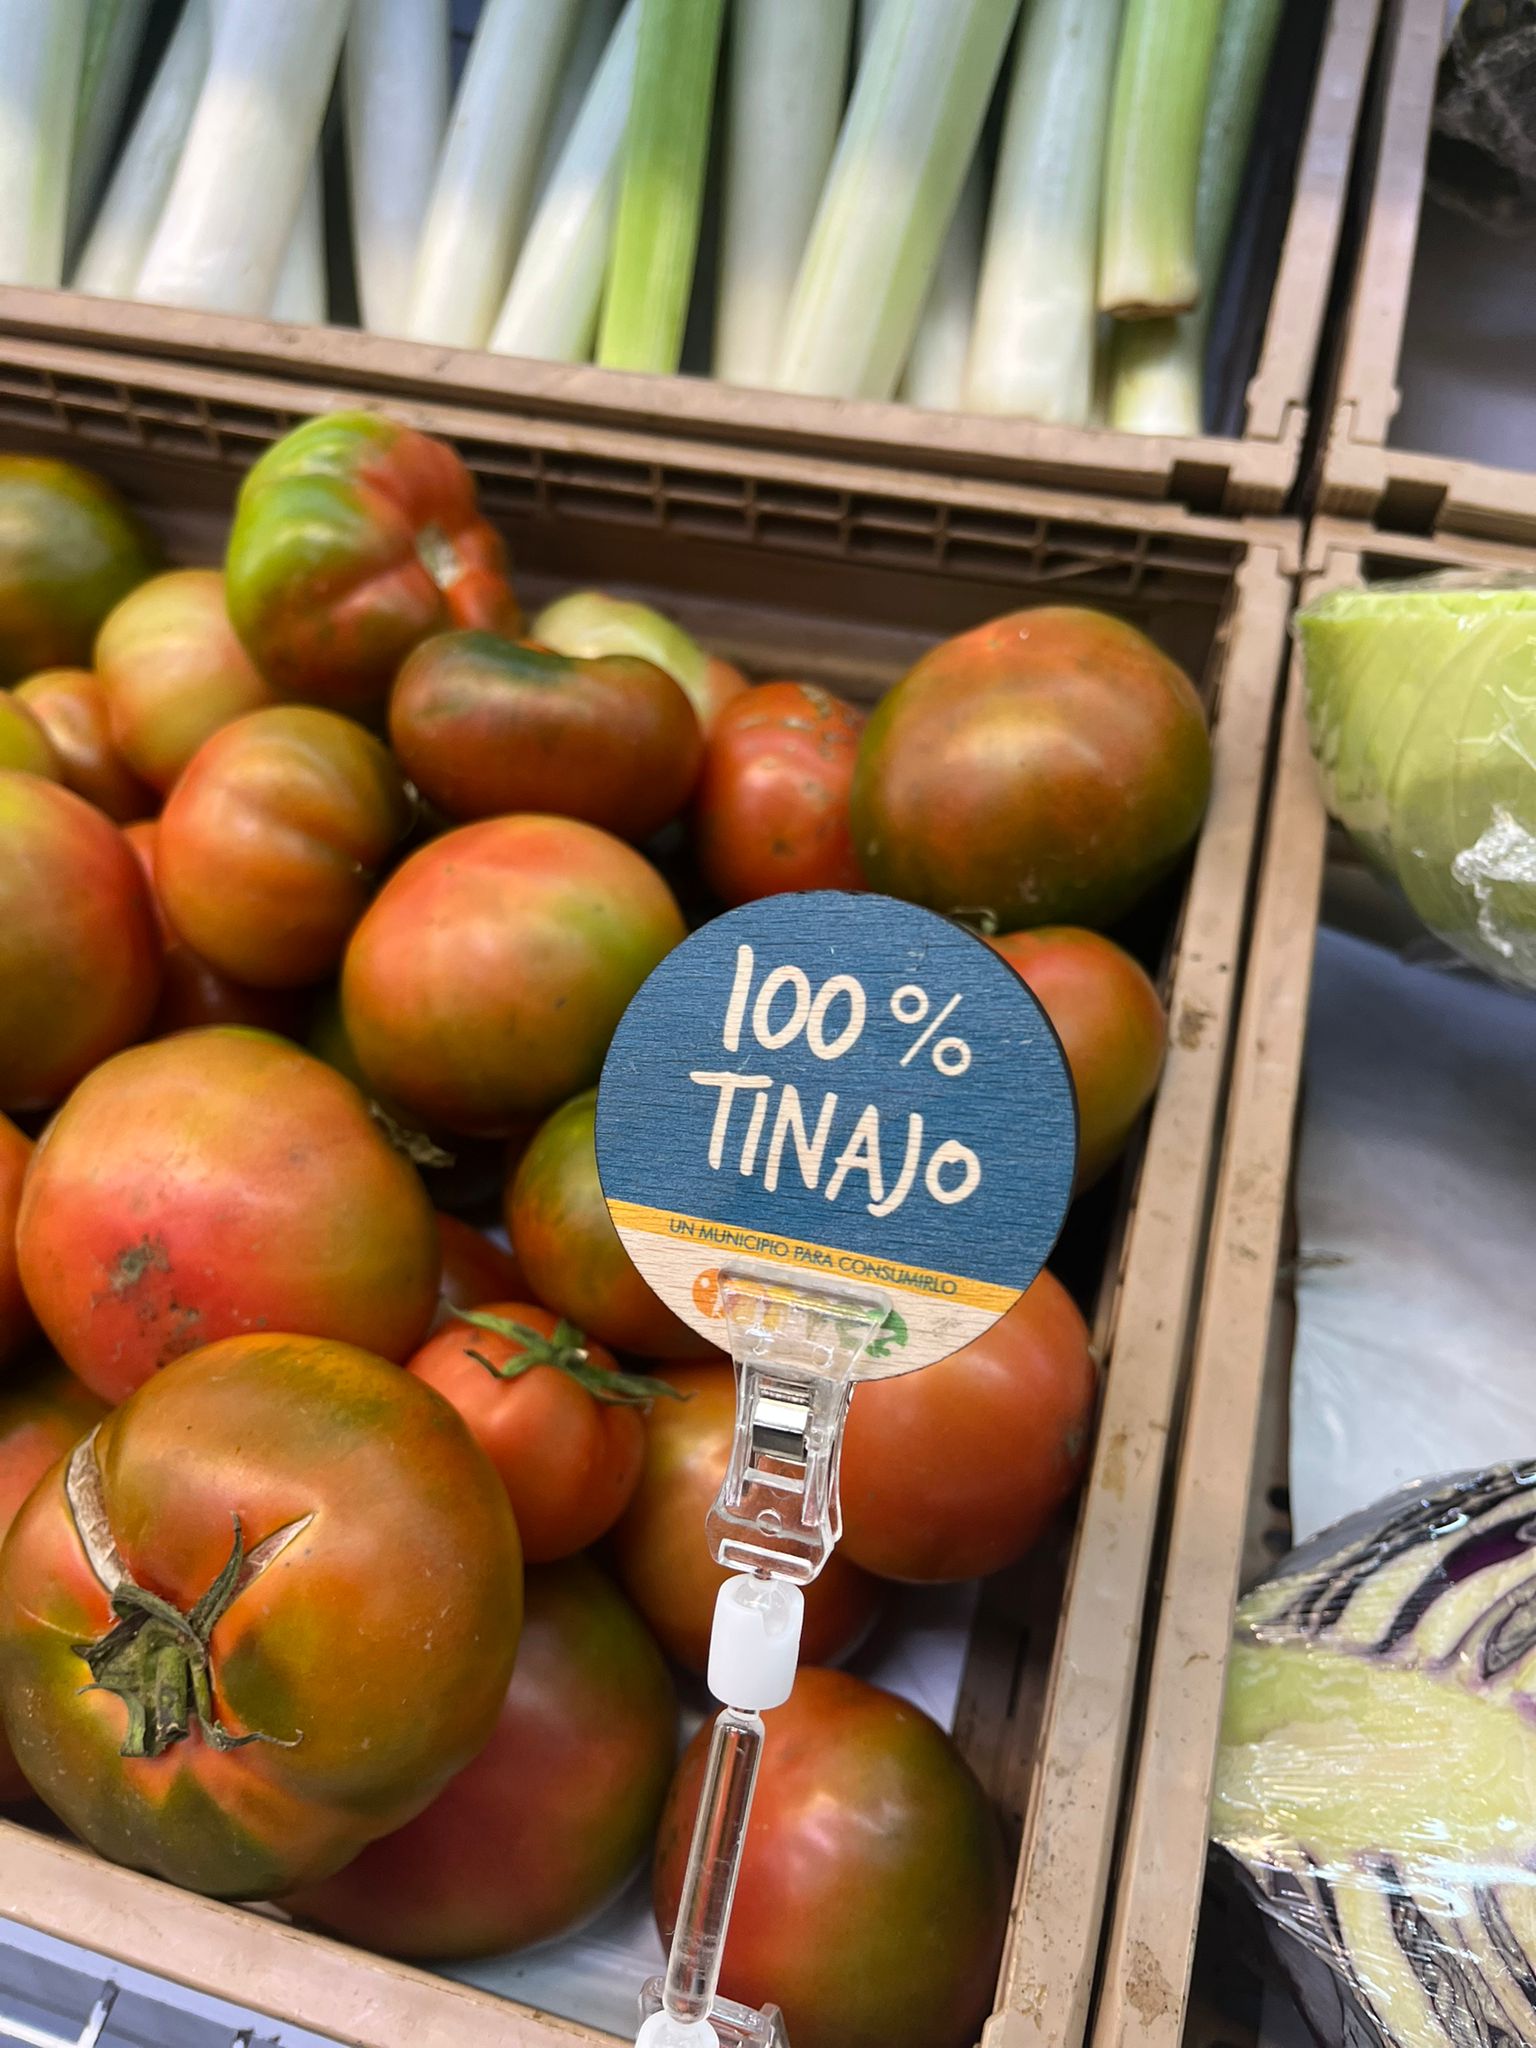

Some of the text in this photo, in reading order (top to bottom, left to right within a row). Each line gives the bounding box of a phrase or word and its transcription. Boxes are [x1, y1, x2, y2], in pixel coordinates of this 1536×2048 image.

[723, 944, 867, 1060] 100
[689, 1070, 982, 1218] TINAJO
[669, 1218, 958, 1295] UN MUNICIPIO PARA CONSUMIRLO
